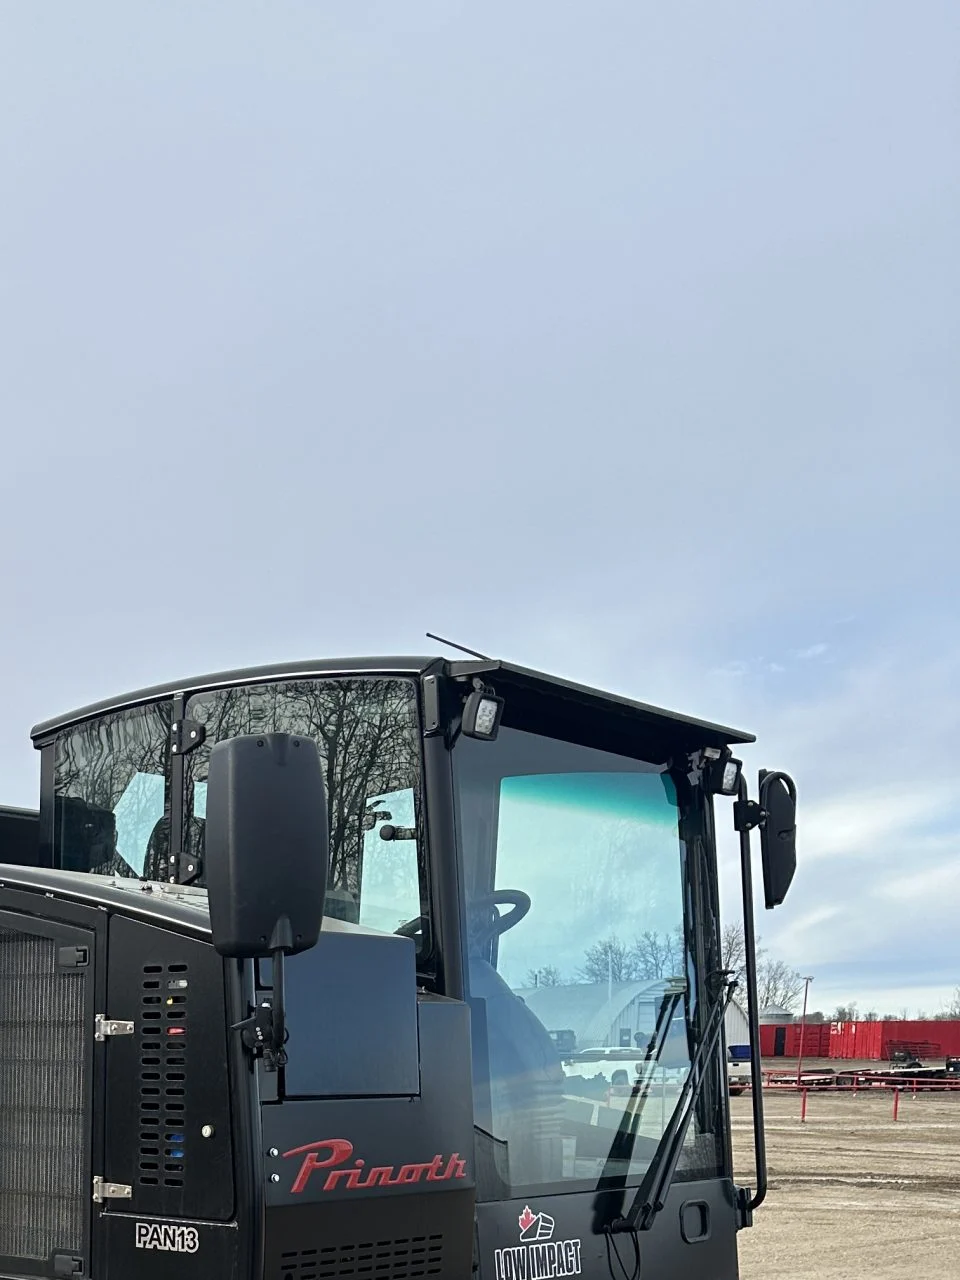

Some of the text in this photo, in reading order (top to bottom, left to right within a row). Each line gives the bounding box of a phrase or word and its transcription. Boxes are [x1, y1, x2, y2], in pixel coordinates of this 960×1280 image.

[282, 1138, 467, 1193] Prinoth
[135, 1222, 200, 1254] PAN13
[528, 1238, 582, 1280] IMPACT
